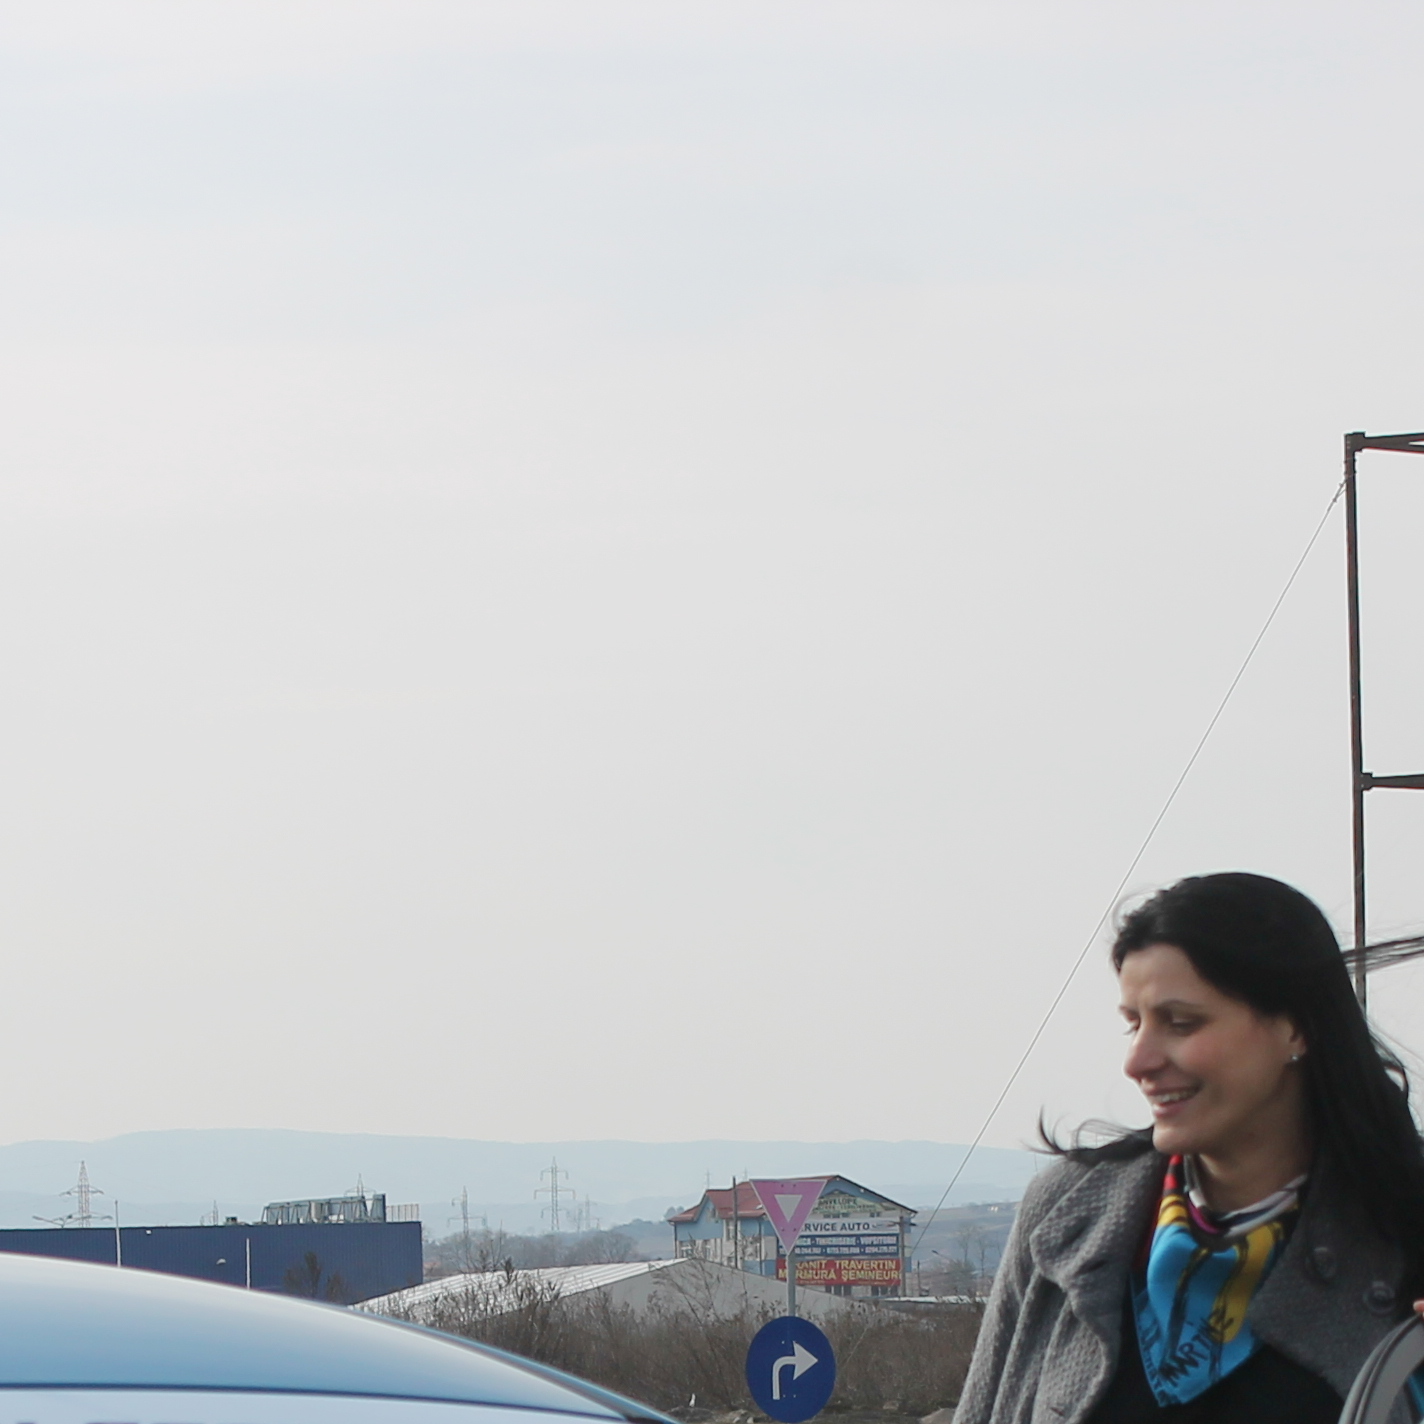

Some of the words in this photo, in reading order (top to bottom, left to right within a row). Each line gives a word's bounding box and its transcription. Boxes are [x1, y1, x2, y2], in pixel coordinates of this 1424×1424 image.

[800, 1223, 837, 1232] RVICE
[839, 1222, 871, 1231] AUTO
[835, 1259, 896, 1270] TRAVERTIN
